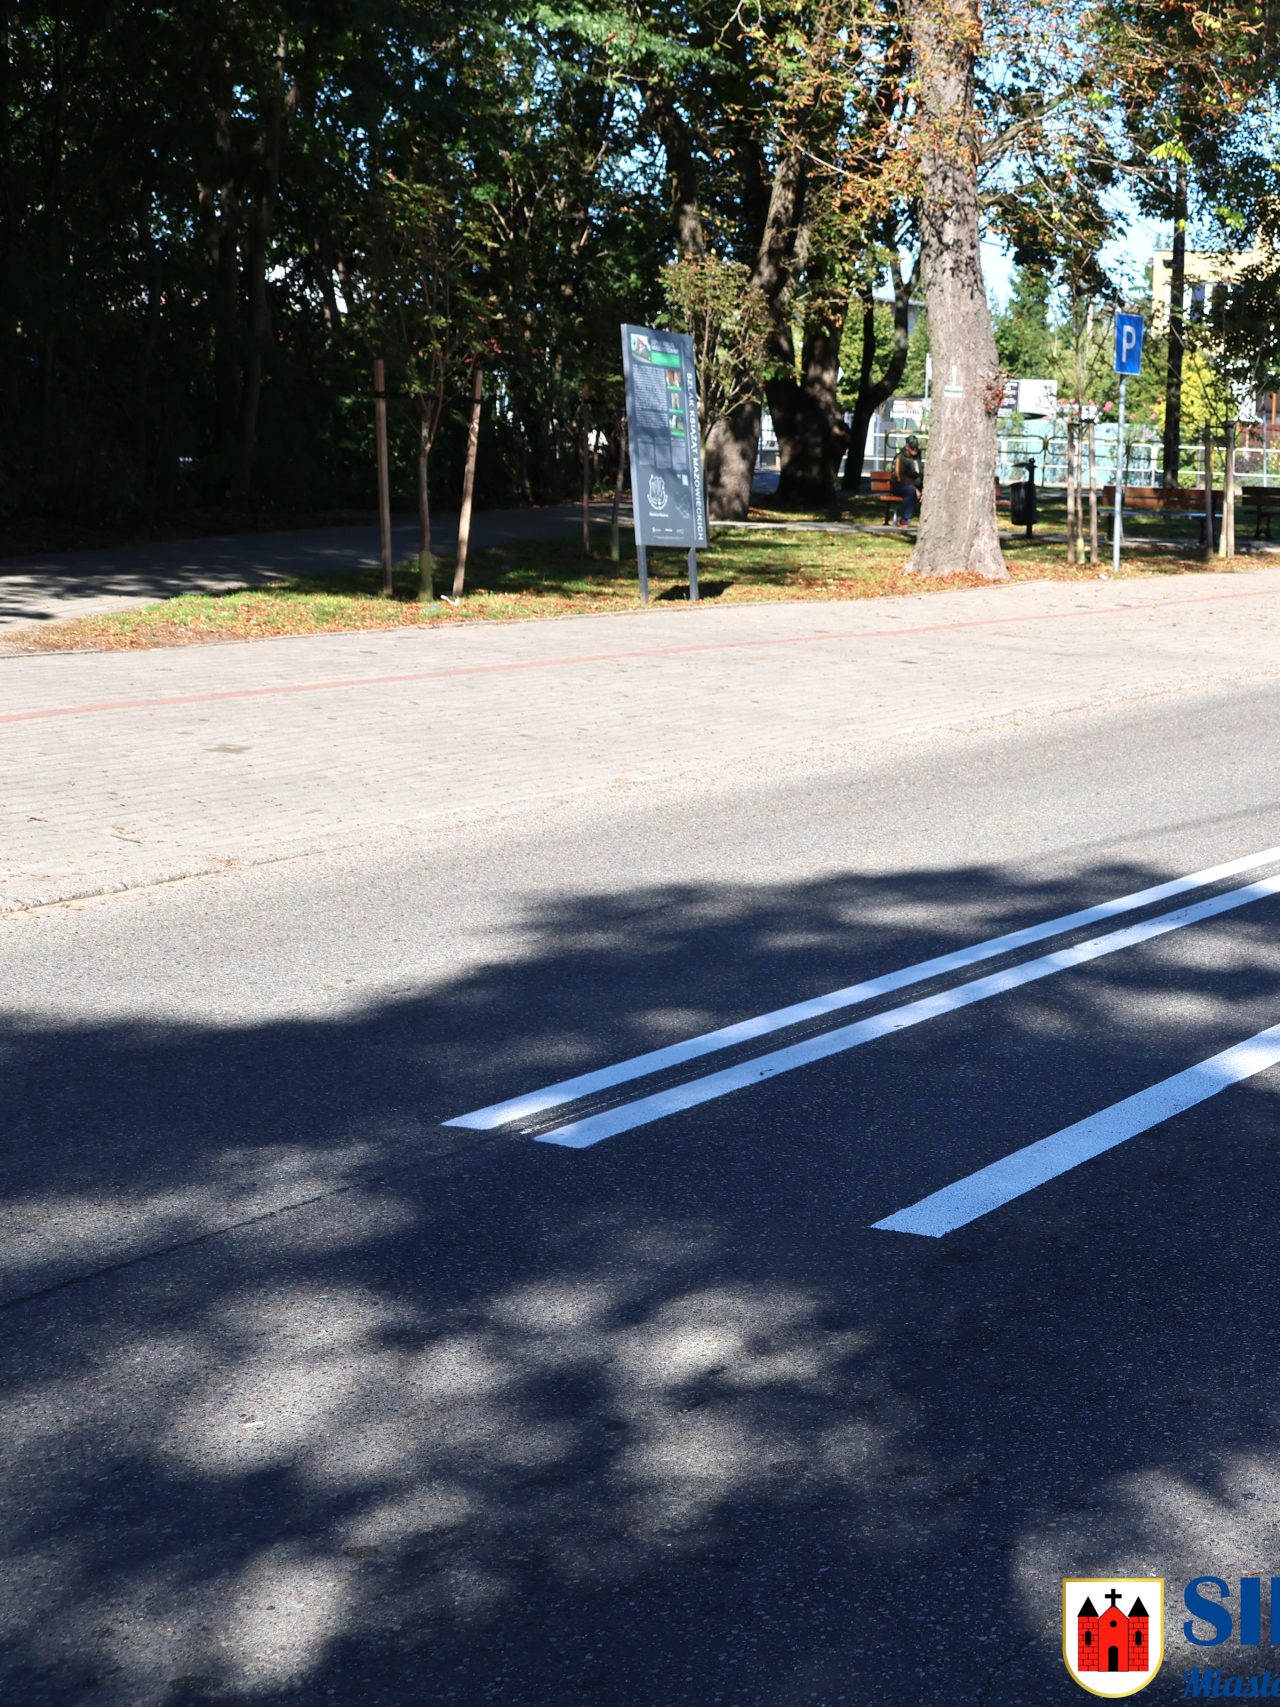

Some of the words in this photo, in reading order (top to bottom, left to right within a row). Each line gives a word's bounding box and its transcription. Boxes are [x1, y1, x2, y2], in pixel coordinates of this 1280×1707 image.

[1120, 325, 1136, 363] P
[686, 372, 695, 407] SZLAK
[693, 457, 704, 541] MAZOWIECKICH
